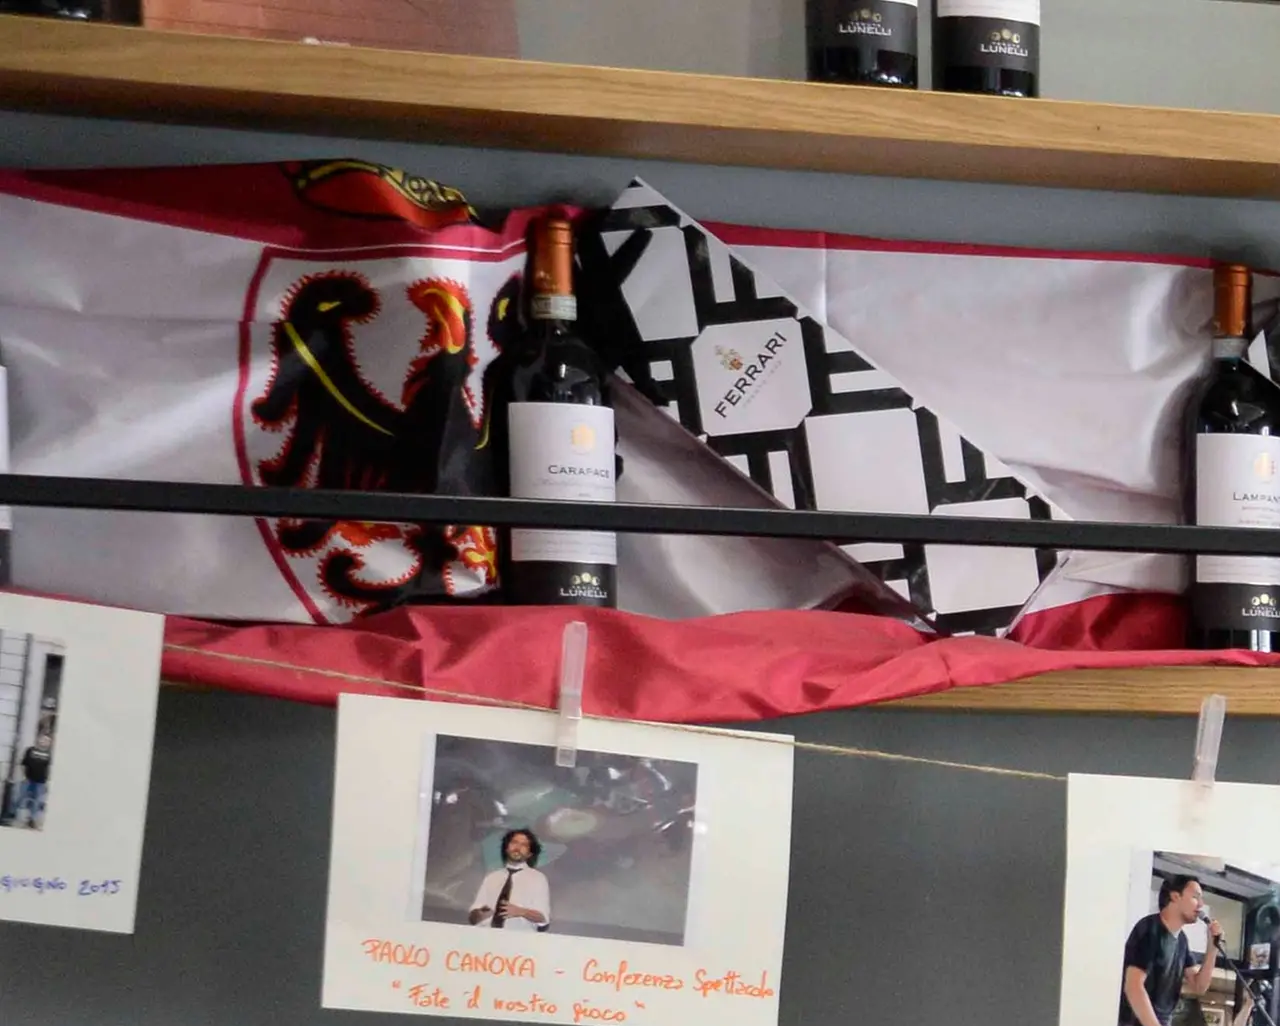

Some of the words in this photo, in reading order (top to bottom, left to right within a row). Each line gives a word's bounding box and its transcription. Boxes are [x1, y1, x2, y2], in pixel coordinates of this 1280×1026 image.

[838, 24, 893, 37] LUNELLI
[981, 43, 1028, 57] LUNELLI
[714, 332, 788, 419] FERRARI
[560, 588, 607, 599] LUNELLI
[77, 880, 122, 896] 2015
[361, 938, 430, 967] PAOLO
[445, 950, 536, 978] CANOVA
[583, 958, 684, 992] Conferenza
[494, 993, 557, 1015] nostro
